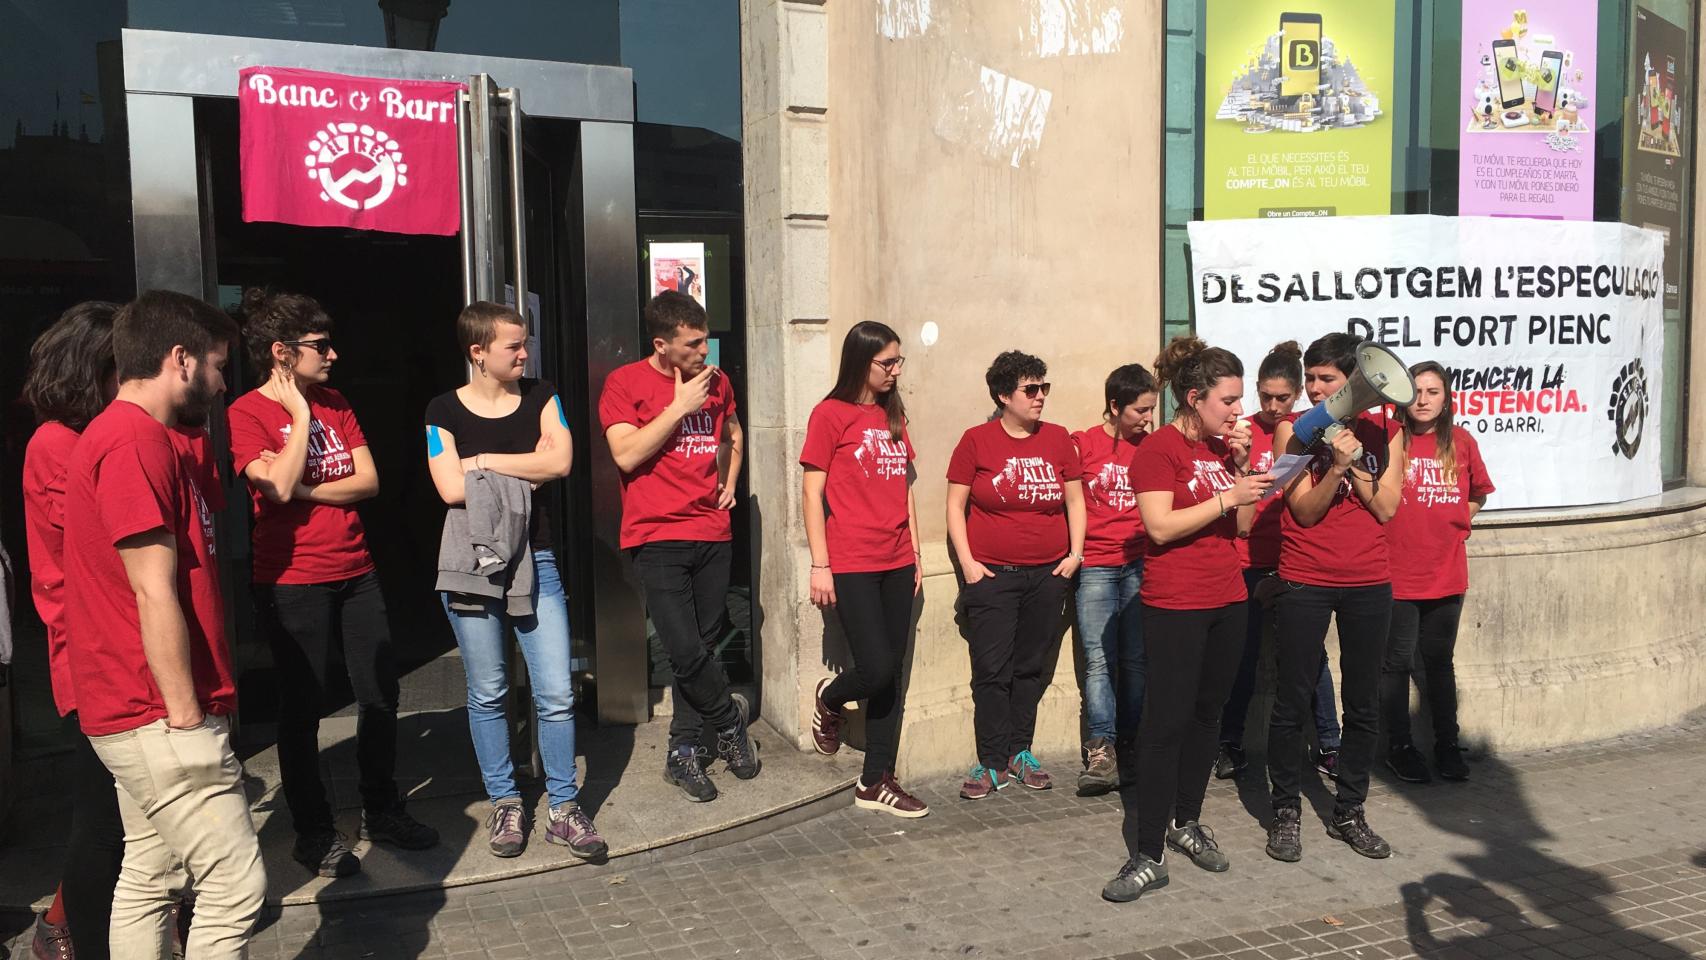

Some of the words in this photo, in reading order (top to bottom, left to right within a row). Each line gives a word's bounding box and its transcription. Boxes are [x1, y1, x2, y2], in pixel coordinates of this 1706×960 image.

[1295, 44, 1313, 66] B
[249, 74, 338, 109] Banc
[1247, 154, 1257, 164] EL
[1260, 153, 1279, 164] QUE
[1282, 152, 1335, 163] NECESSITES
[1337, 150, 1350, 162] ÉS
[1473, 154, 1483, 165] TU
[1484, 153, 1504, 165] MÓVIL
[1507, 156, 1515, 165] TE
[1516, 156, 1551, 167] RECUERDA
[1553, 158, 1567, 169] QUE
[1568, 159, 1583, 169] HOY
[1228, 167, 1238, 177] AL
[1242, 166, 1260, 177] TEU
[1294, 166, 1312, 176] PER
[1314, 163, 1336, 175] AIXÒ
[1338, 165, 1347, 174] EL
[1351, 163, 1369, 174] TEU
[1476, 167, 1485, 177] ES
[1487, 167, 1494, 177] EL
[1496, 167, 1541, 179] CUMPLEAÑOS
[1542, 169, 1552, 179] DE
[1226, 178, 1289, 190] COMPTE_ON
[1292, 176, 1303, 188] ÉS
[1306, 178, 1316, 188] AL
[1320, 177, 1338, 187] TEU
[1474, 180, 1480, 189] Y
[1481, 180, 1496, 190] CON
[1498, 180, 1508, 190] TU
[1509, 179, 1529, 191] MÓVIL
[1531, 181, 1553, 192] PONES
[1554, 182, 1579, 193] DINERO
[1500, 192, 1518, 202] PARA
[1520, 193, 1527, 203] EL
[1267, 209, 1281, 217] Obre
[1291, 209, 1328, 218] Compte_ON
[1202, 266, 1481, 304] DESALLOTGEM
[1347, 316, 1421, 348] DEL
[1434, 314, 1517, 347] FORT
[1529, 313, 1611, 345] PIENC
[1446, 365, 1533, 391] MENCEM
[1541, 364, 1566, 390] LA
[682, 411, 712, 434] ALLÒ
[1477, 418, 1488, 434] O
[675, 442, 686, 453] el
[686, 438, 719, 458] futur
[877, 464, 885, 475] el
[886, 460, 906, 481] futu
[1020, 457, 1045, 468] TENIM
[1115, 465, 1129, 475] TEN
[1023, 462, 1057, 483] ALLÒ
[1114, 474, 1134, 490] AL
[1018, 489, 1030, 500] el
[1030, 486, 1063, 504] futur
[1108, 497, 1118, 506] el
[1118, 493, 1137, 511] fut
[1417, 492, 1427, 502] el
[1427, 489, 1461, 508] futur
